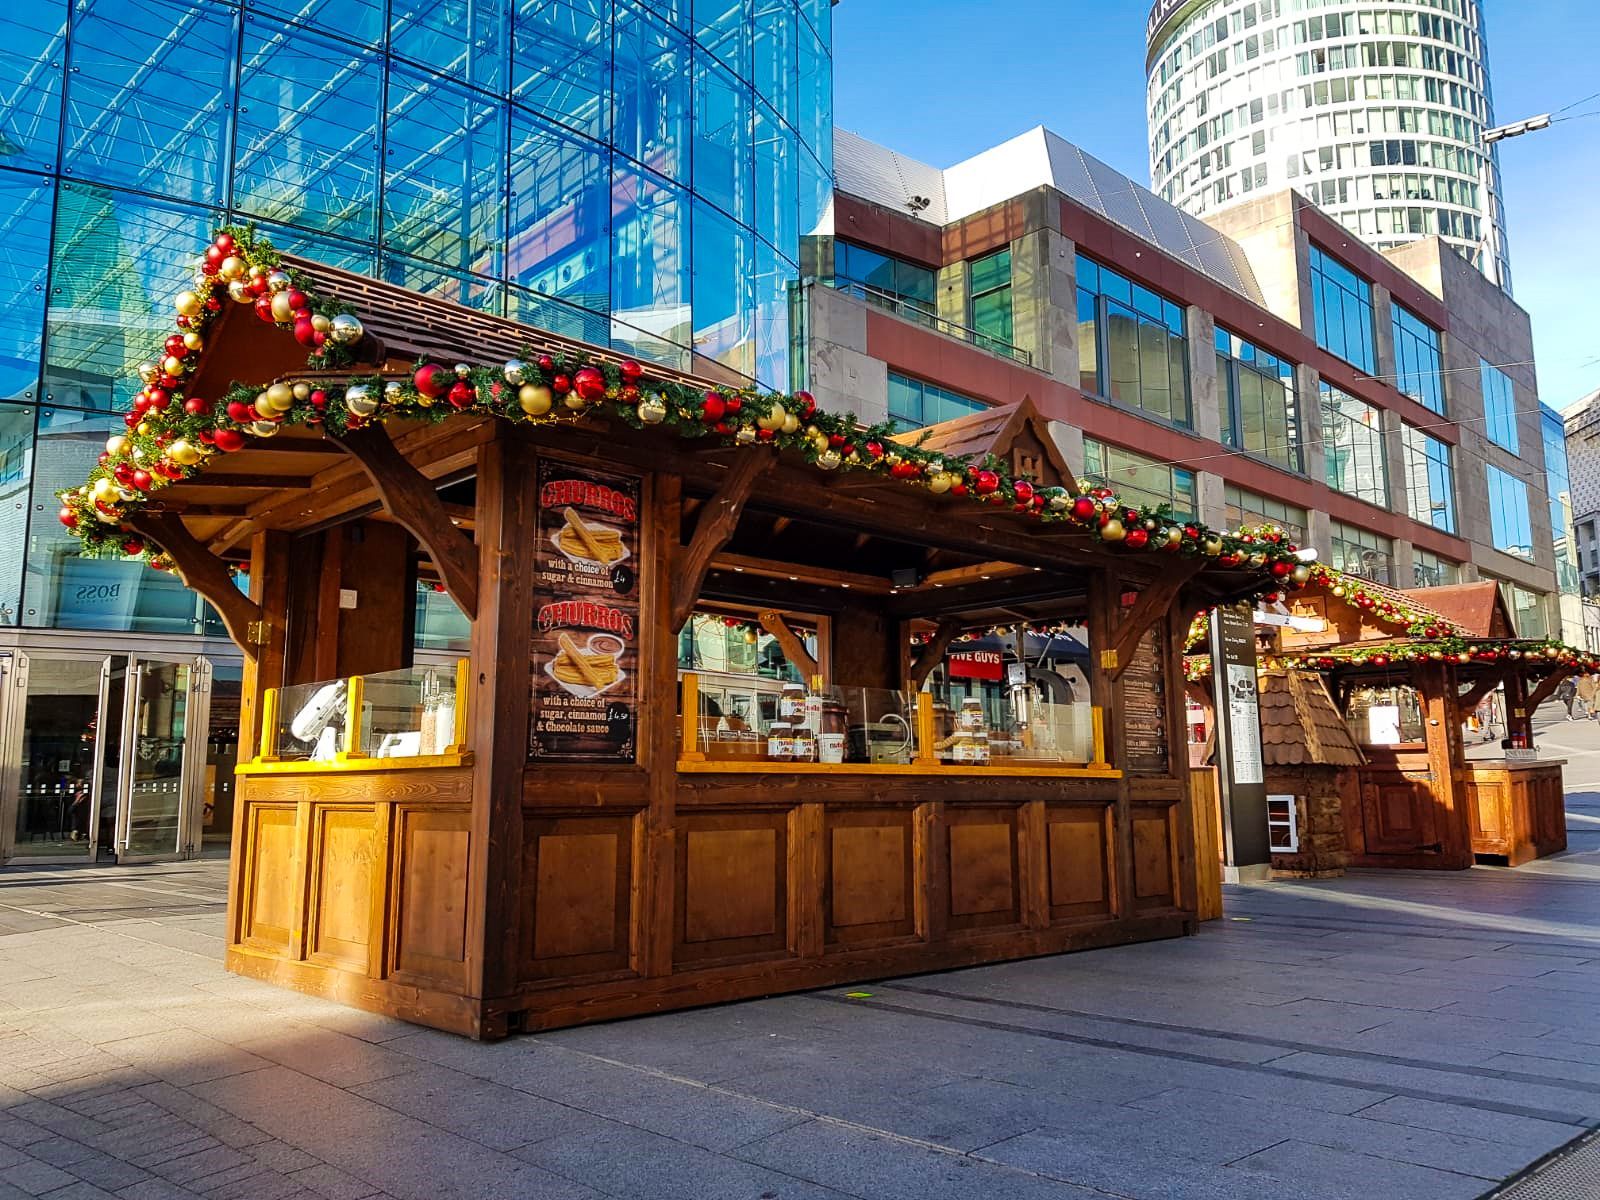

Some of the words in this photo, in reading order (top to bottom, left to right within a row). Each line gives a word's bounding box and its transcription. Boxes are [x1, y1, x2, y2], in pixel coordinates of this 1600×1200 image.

[541, 479, 637, 523] CHURROS
[548, 559, 566, 570] with
[568, 562, 573, 571] a
[574, 562, 600, 575] choice
[601, 566, 609, 576] of
[542, 571, 566, 583] sugar
[567, 573, 575, 584] &
[575, 574, 614, 589] cinnamon
[537, 600, 634, 641] CHURROS
[974, 651, 1000, 665] GUYS
[543, 694, 561, 706] with
[563, 697, 569, 706] a
[570, 696, 596, 708] choice
[597, 697, 606, 708] of
[540, 709, 567, 721] sugar,
[567, 709, 607, 721] cinnamon
[536, 720, 544, 731] &
[545, 720, 585, 733] Chocolate
[587, 724, 609, 733] sauce
